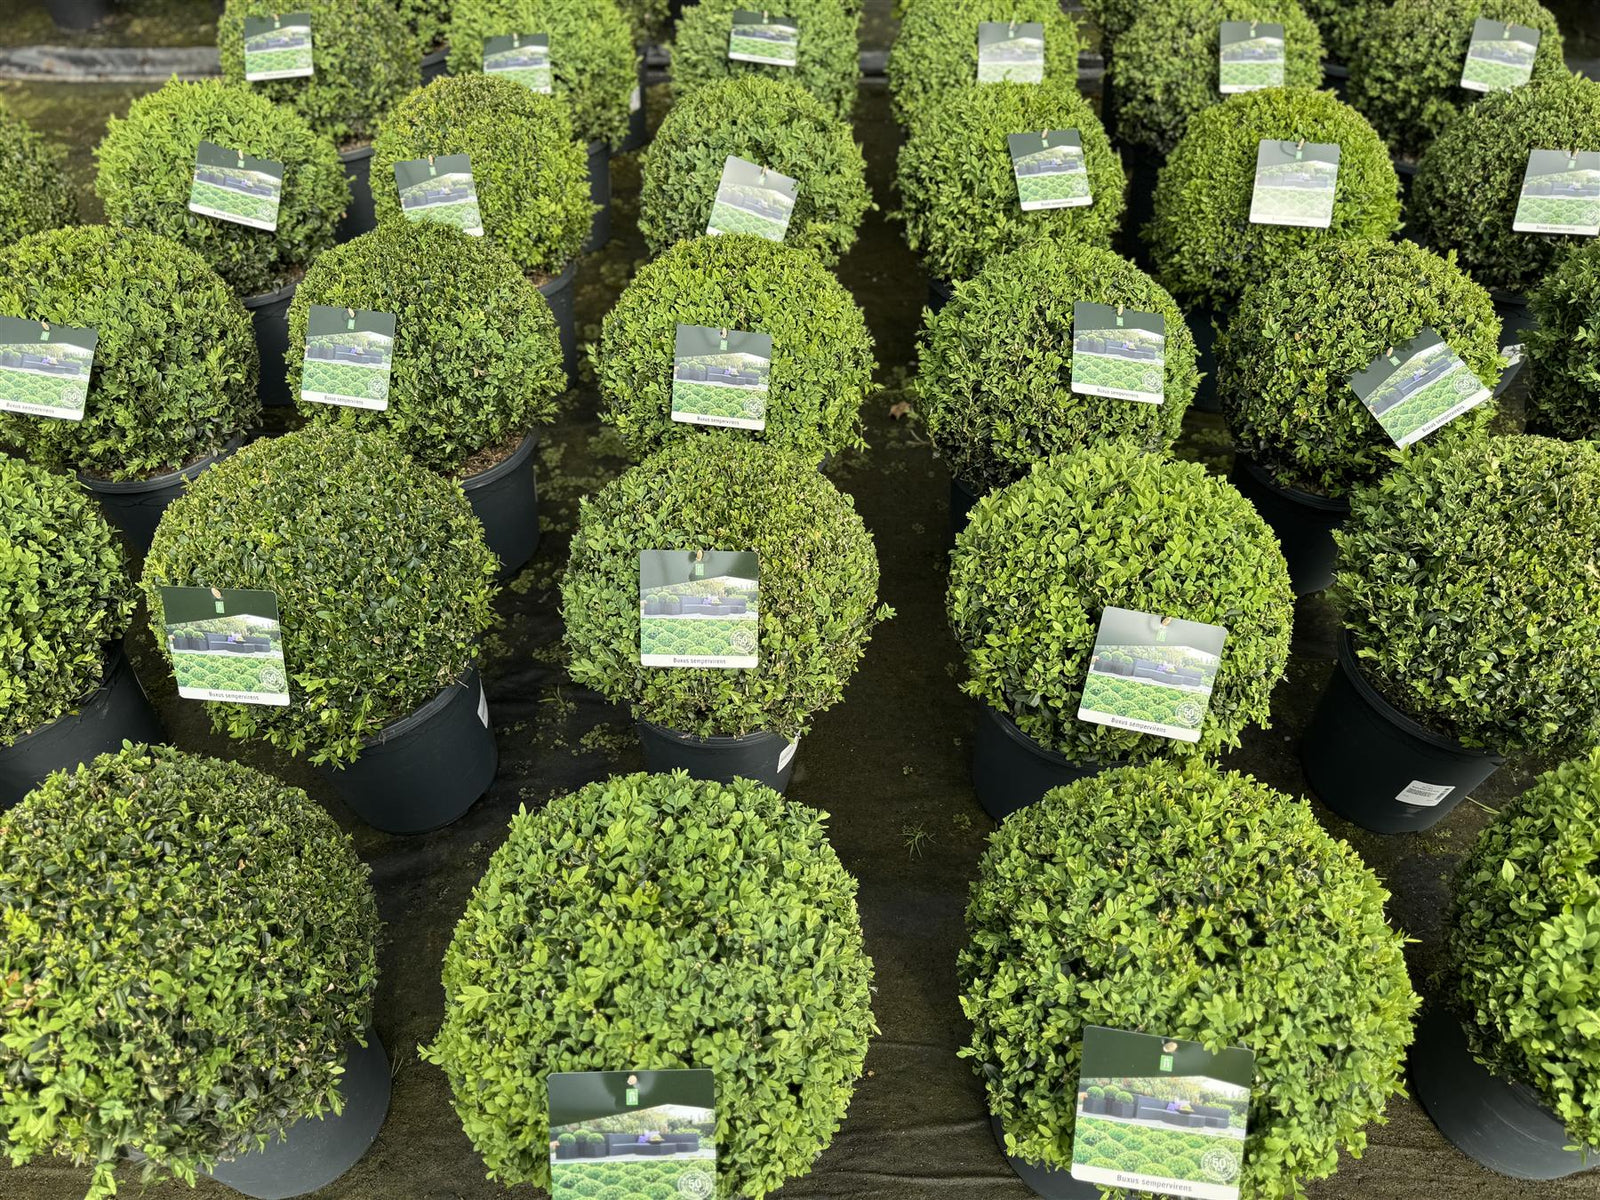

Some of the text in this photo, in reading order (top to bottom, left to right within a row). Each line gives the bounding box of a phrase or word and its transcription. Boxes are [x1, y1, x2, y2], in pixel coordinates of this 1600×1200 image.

[1111, 717, 1166, 734] Buxus sempervirens
[1212, 1157, 1226, 1169] 50
[1116, 1174, 1193, 1192] Buxus sempervirens
